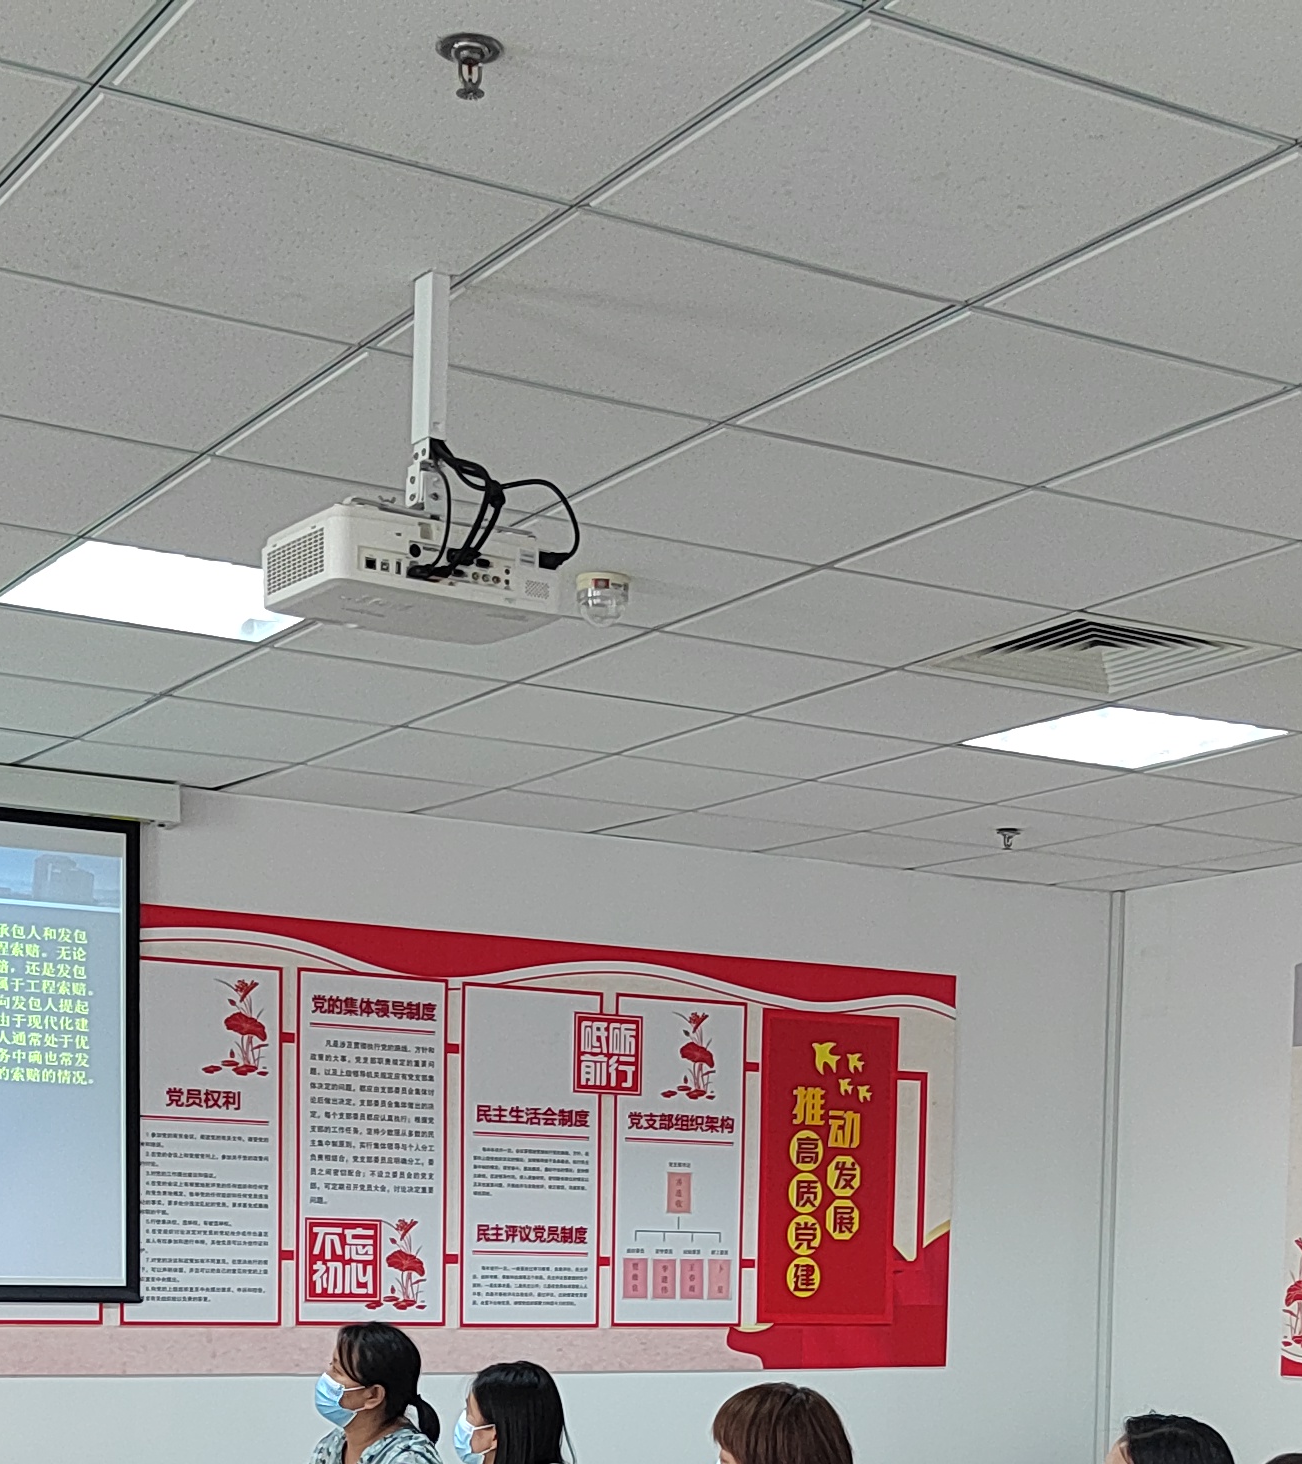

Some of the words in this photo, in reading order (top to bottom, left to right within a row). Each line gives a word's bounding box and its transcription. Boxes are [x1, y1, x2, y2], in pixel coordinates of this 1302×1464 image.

[311, 994, 438, 1022] 党的集体领导制度
[581, 1020, 636, 1055] 砥砺
[581, 1054, 636, 1088] 前行
[165, 1087, 242, 1111] 党员权利
[476, 1104, 590, 1128] 民主生活会制度
[627, 1110, 735, 1135] 党支部组织架构
[312, 1226, 375, 1261] 不忘
[476, 1223, 588, 1244] 民主评议党员制度
[312, 1260, 374, 1295] 初心
